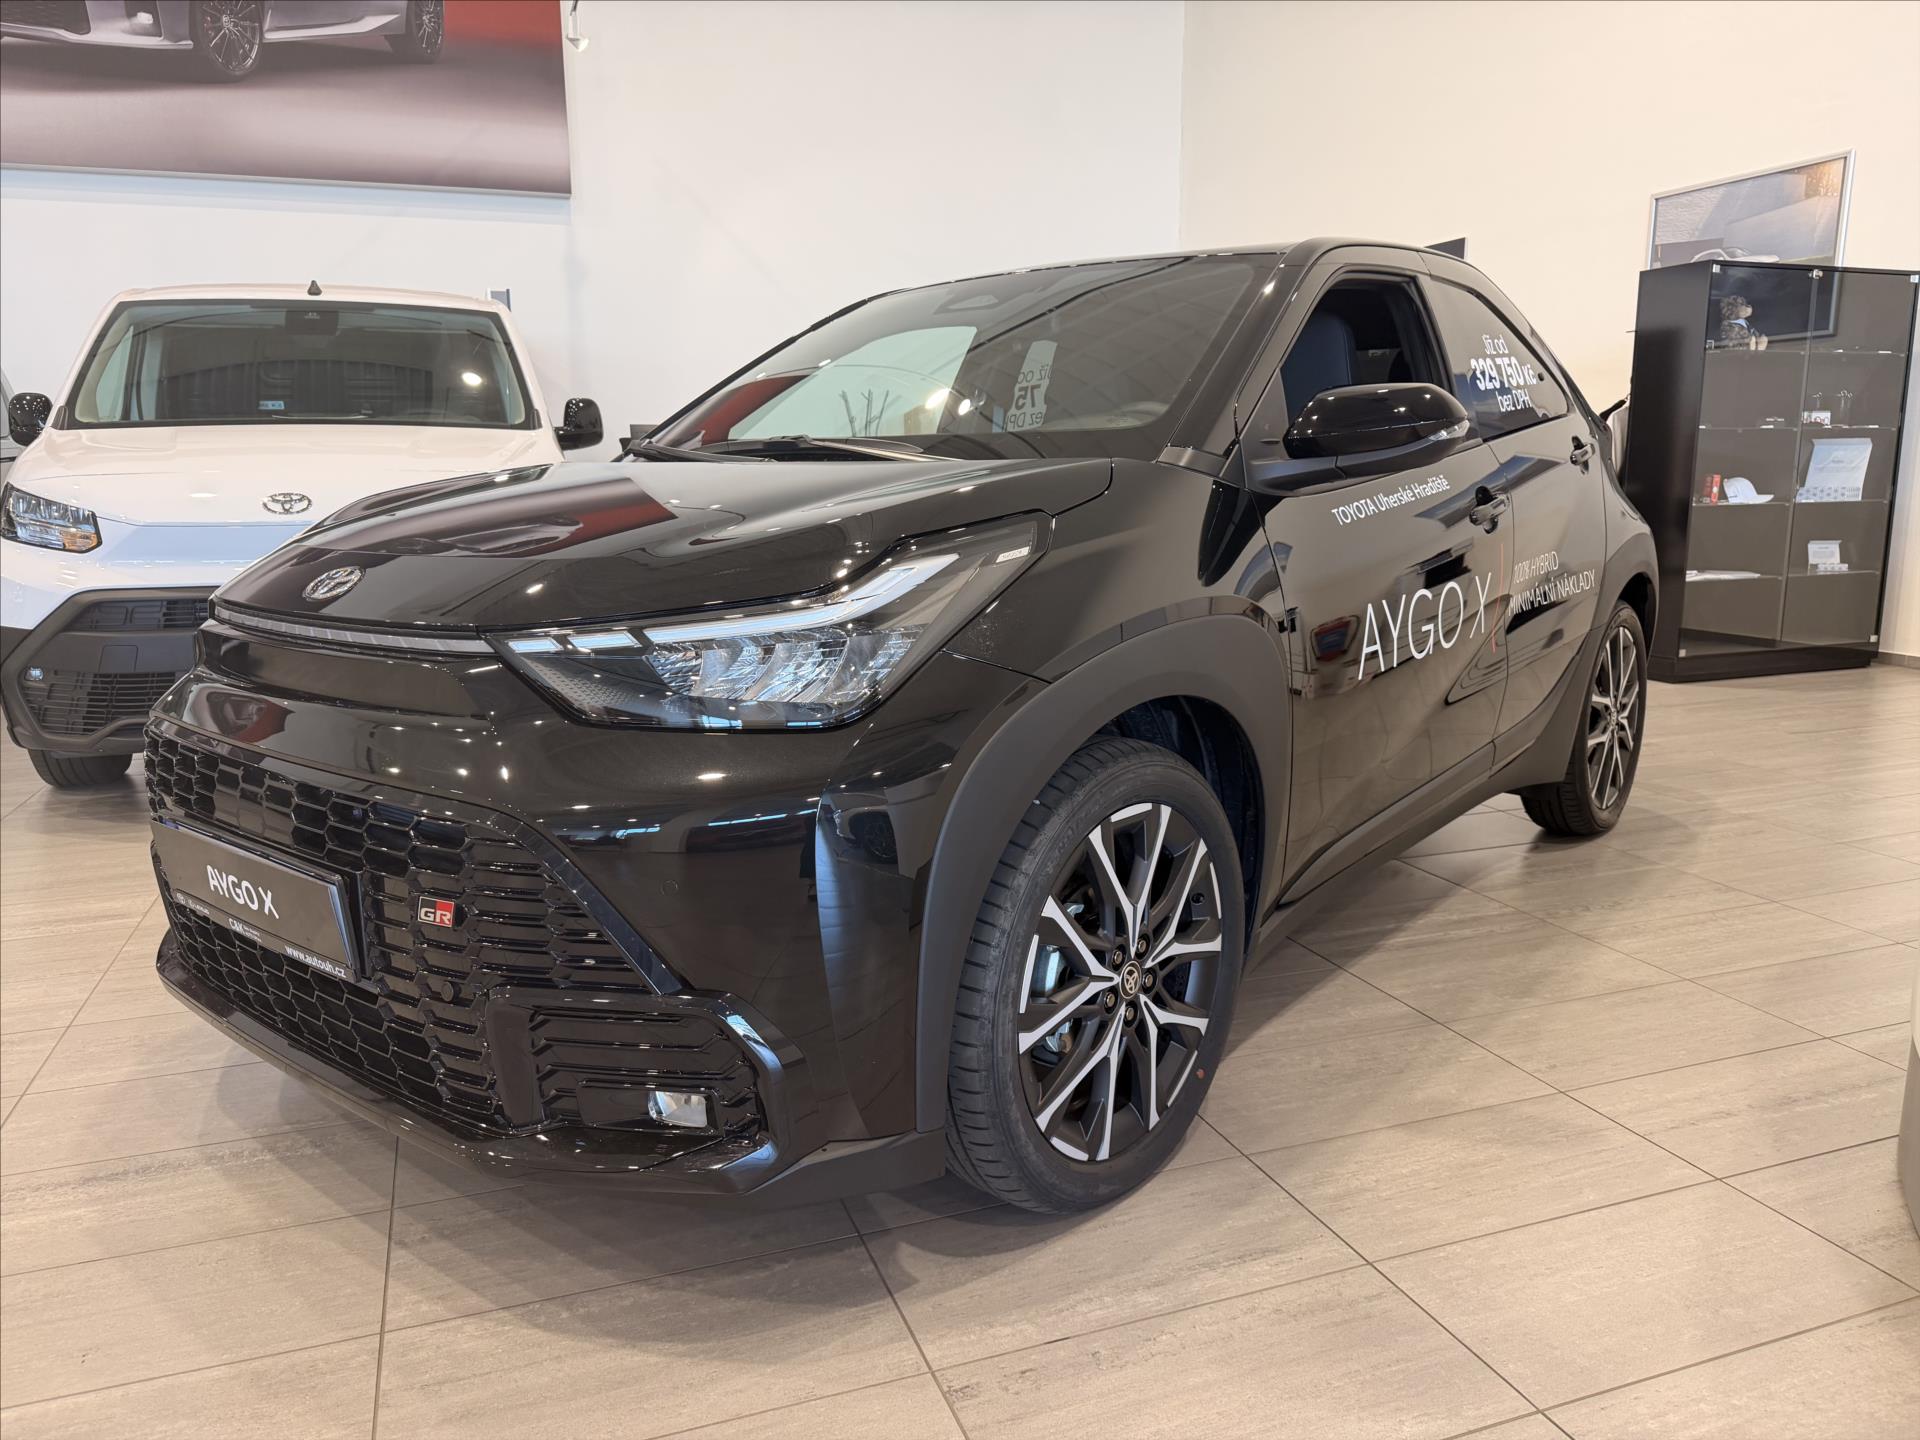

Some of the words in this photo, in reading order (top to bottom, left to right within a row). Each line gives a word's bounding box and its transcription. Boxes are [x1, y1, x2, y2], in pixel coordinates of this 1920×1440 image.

[1494, 334, 1509, 354] od
[1470, 357, 1501, 391] 329
[1494, 356, 1525, 388] 750
[1495, 390, 1515, 412] bez
[1512, 388, 1532, 410] DPH
[1331, 498, 1378, 526] TOYOTA
[1373, 485, 1415, 511] Uherské
[1410, 474, 1451, 500] Hradiště
[1530, 551, 1559, 577] HYBRID
[1508, 577, 1557, 616] MINIMÁLNÍ
[1556, 569, 1595, 599] NÁKLADY
[1358, 581, 1464, 680] AYGO
[1469, 572, 1492, 639] X
[206, 864, 259, 911] AYGO
[258, 886, 280, 920] X
[420, 907, 451, 925] GR
